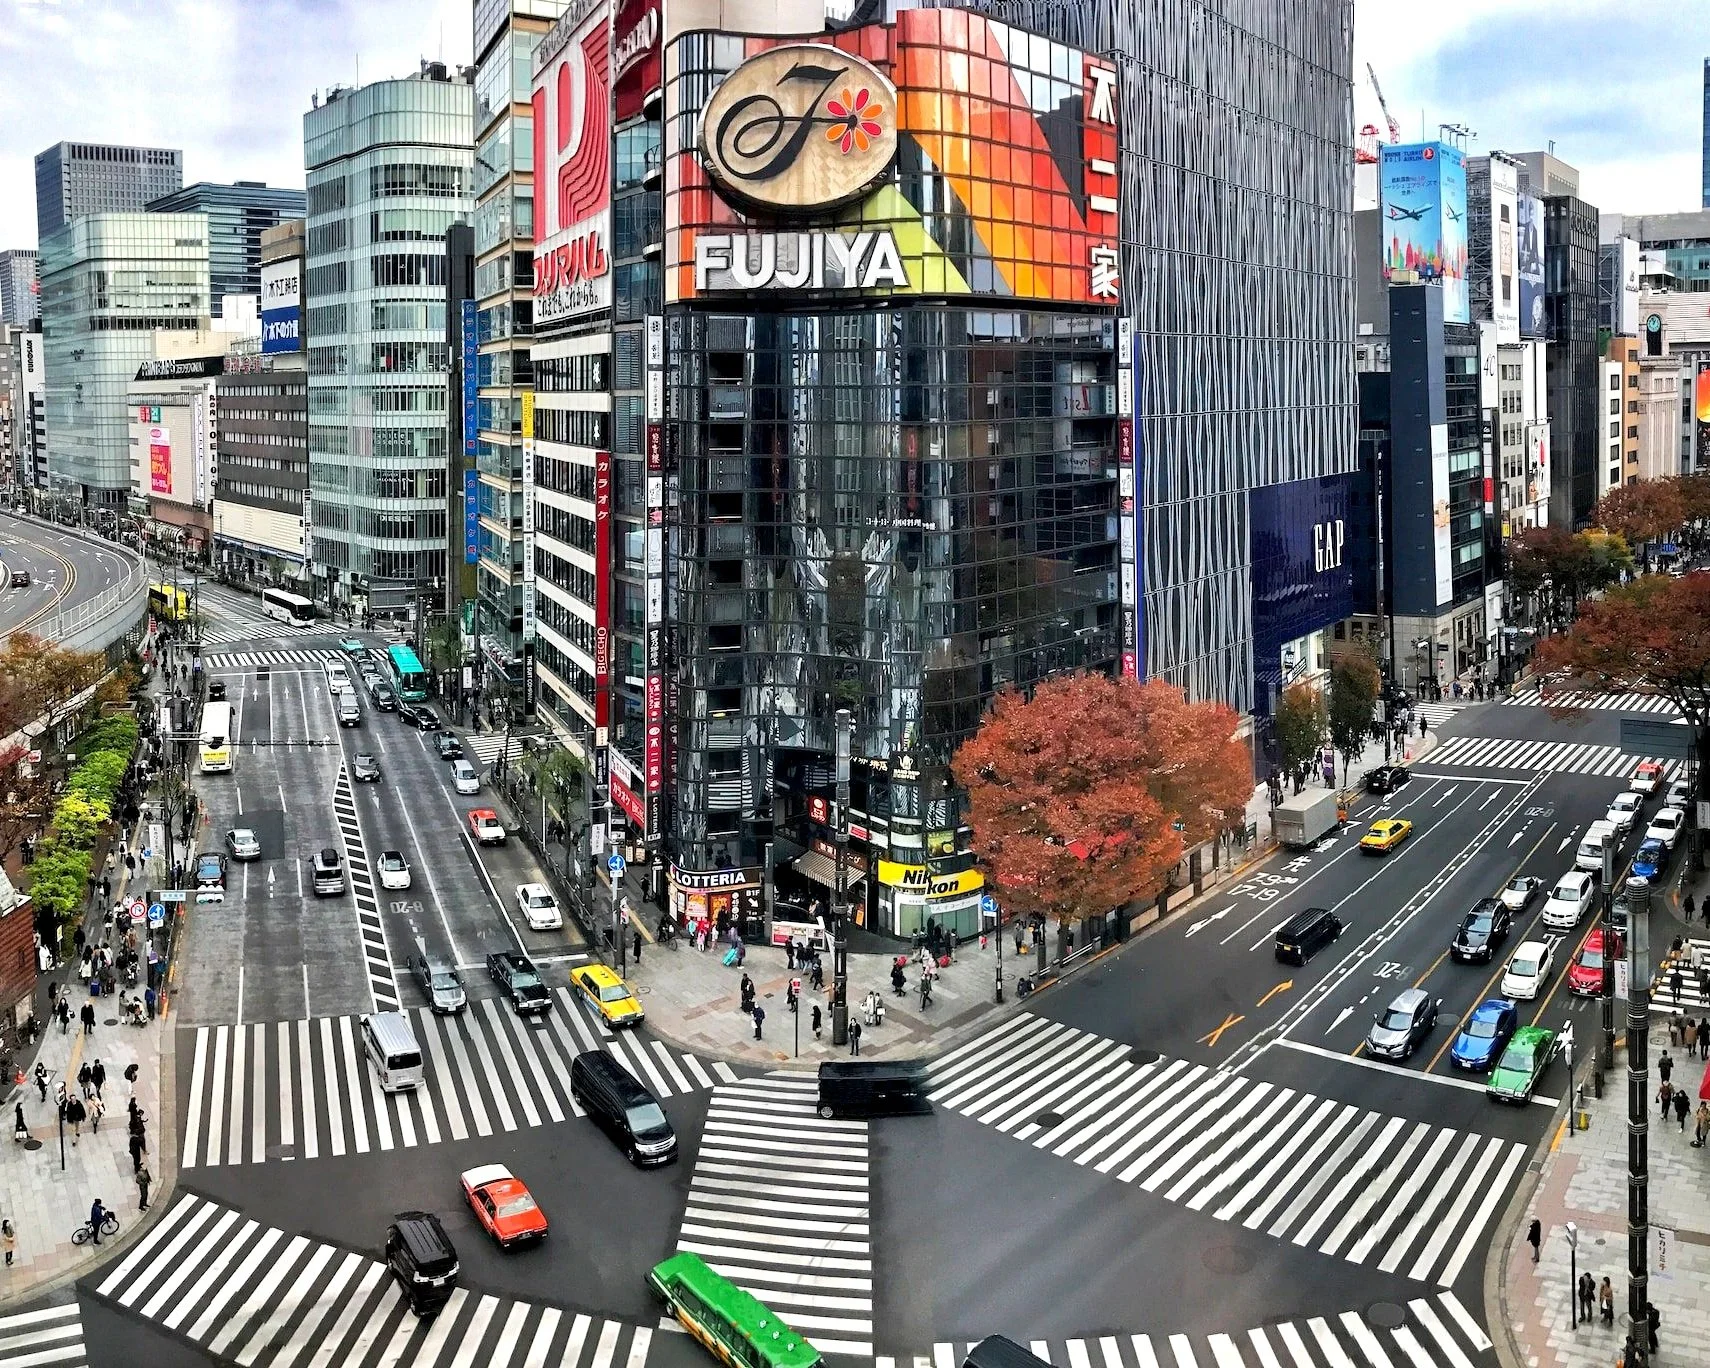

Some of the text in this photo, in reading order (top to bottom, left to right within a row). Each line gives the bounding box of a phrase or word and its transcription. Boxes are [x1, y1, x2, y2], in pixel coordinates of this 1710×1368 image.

[1089, 65, 1120, 298] 不二家
[695, 231, 908, 290] FUJIYA
[598, 461, 608, 520] カラオケ
[1314, 519, 1344, 573] GAP
[649, 737, 659, 776] 不二家
[612, 782, 631, 806] カラオケ
[675, 872, 746, 887] LOTTERIA
[1227, 884, 1280, 901] 17-19
